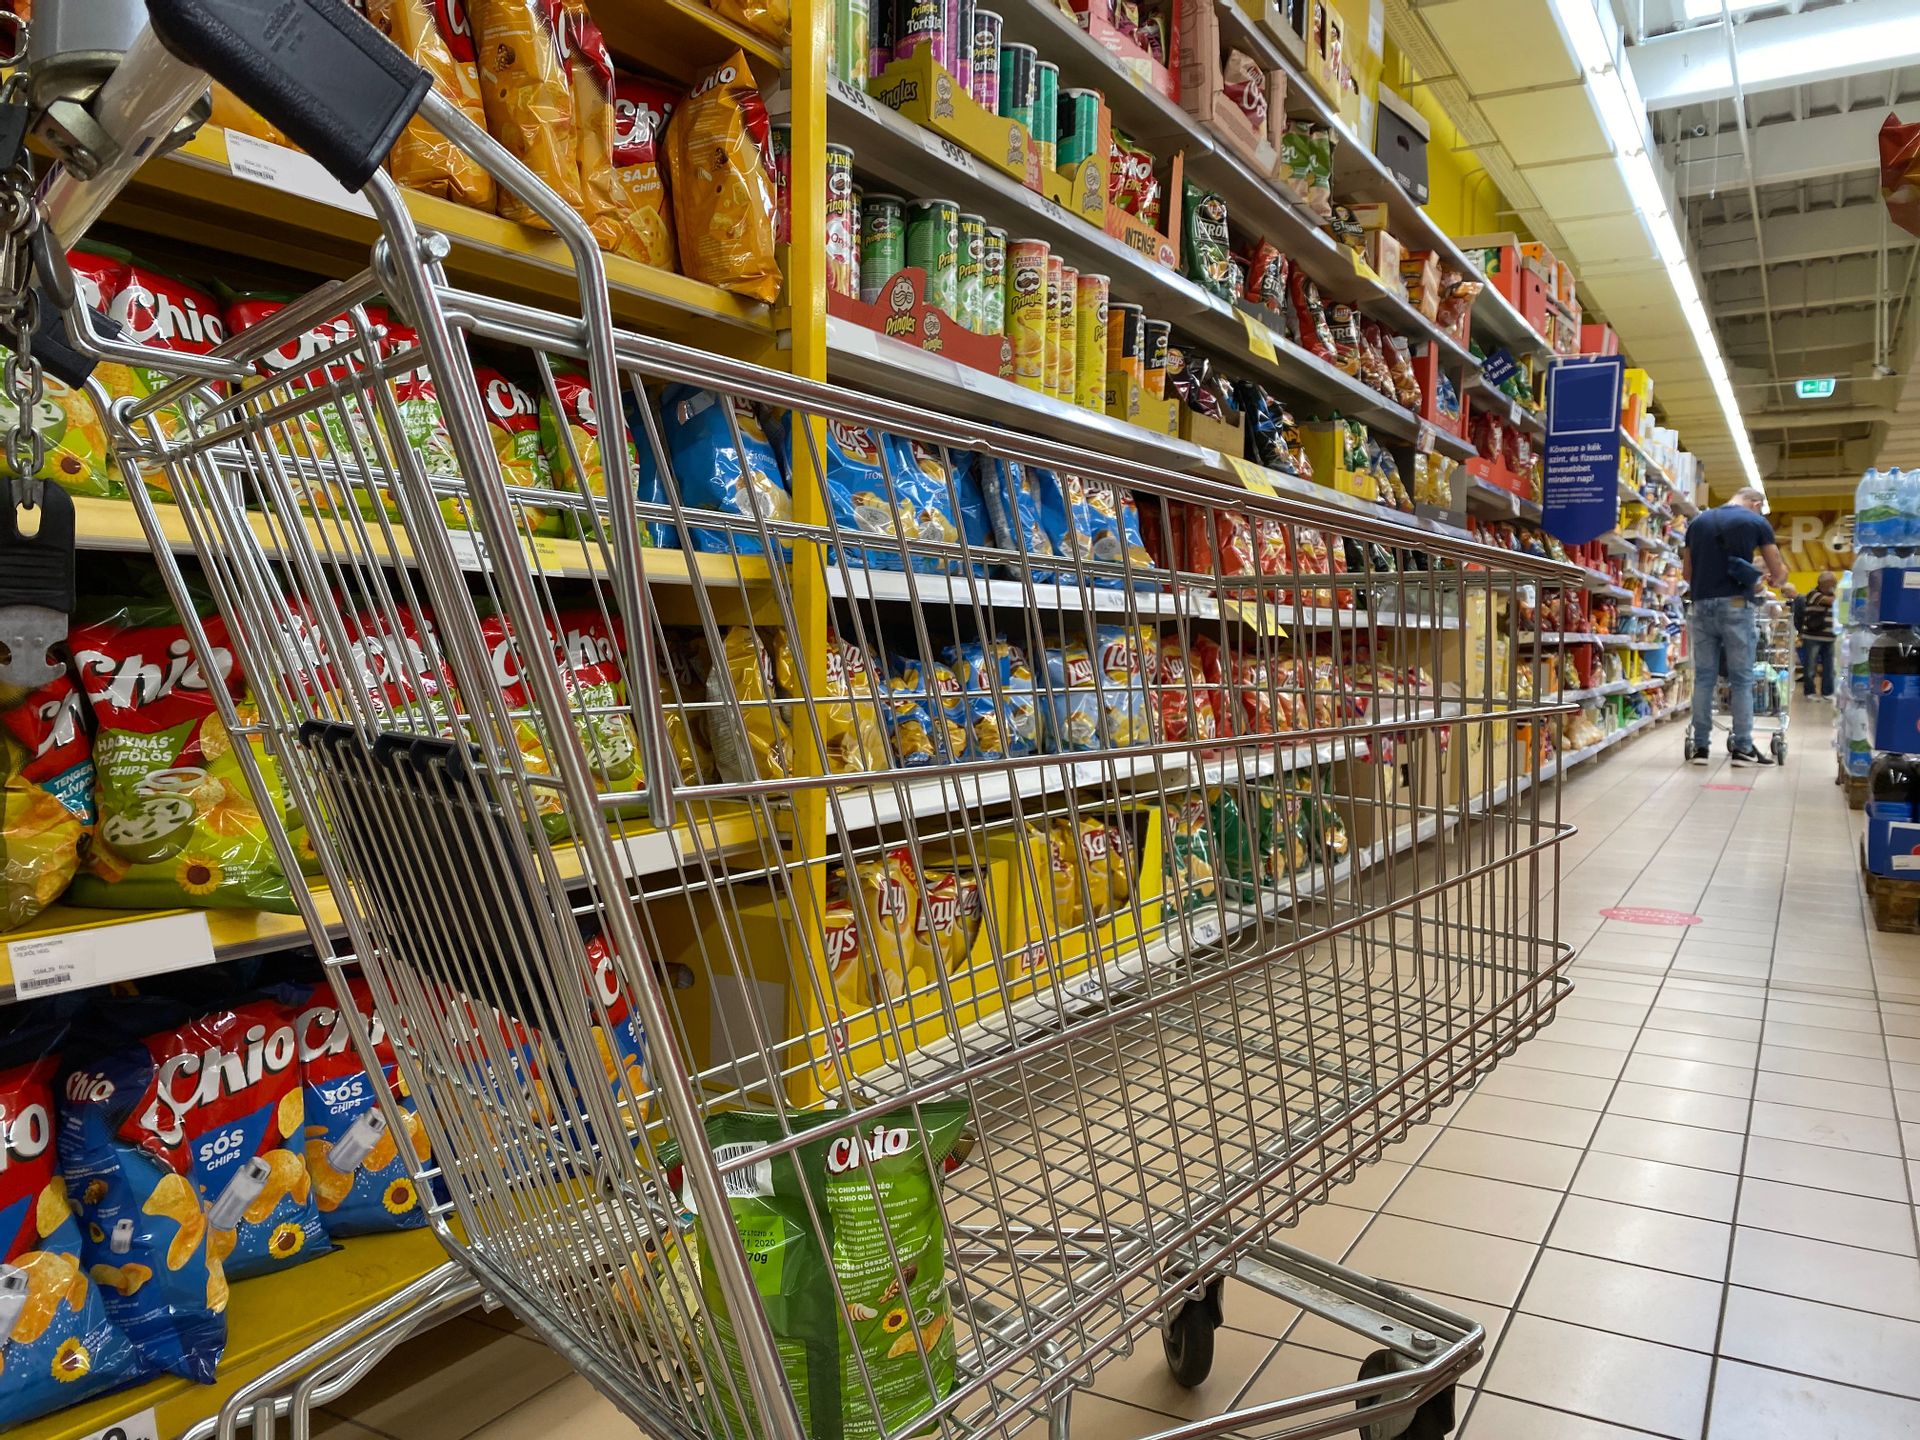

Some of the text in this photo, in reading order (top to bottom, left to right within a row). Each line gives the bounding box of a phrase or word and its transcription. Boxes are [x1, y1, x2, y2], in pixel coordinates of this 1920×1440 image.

[907, 14, 943, 34] Tortilla
[838, 80, 867, 109] 459
[876, 79, 918, 110] ringles
[613, 98, 672, 145] Chi
[941, 140, 967, 166] 999
[1125, 227, 1156, 256] INTENSE
[1198, 222, 1228, 238] STRON
[1011, 291, 1042, 314] Pringle
[109, 285, 224, 344] Chio
[886, 313, 916, 336] Pringles
[487, 379, 538, 418] Chi
[1549, 445, 1579, 453] Kövesse
[1587, 442, 1602, 451] kék
[1581, 453, 1614, 462] fizessen
[1548, 473, 1595, 485] minden nap!
[1549, 465, 1591, 473] kevesebbet
[75, 638, 234, 712] Chio
[54, 764, 94, 790] TENGER
[109, 765, 148, 776] CHIPS
[67, 1070, 115, 1102] Chio
[142, 1025, 295, 1138] Chio
[325, 1081, 363, 1105] SÓS
[330, 1098, 361, 1113] CHIPS
[199, 1129, 244, 1162] SÓS
[827, 1125, 909, 1173] Chio
[207, 1148, 241, 1171] CHIPS
[857, 1182, 893, 1192] MINÉG/
[858, 1192, 889, 1201] QUATY
[755, 1239, 775, 1247] 2020
[837, 1271, 864, 1279] PERIOR
